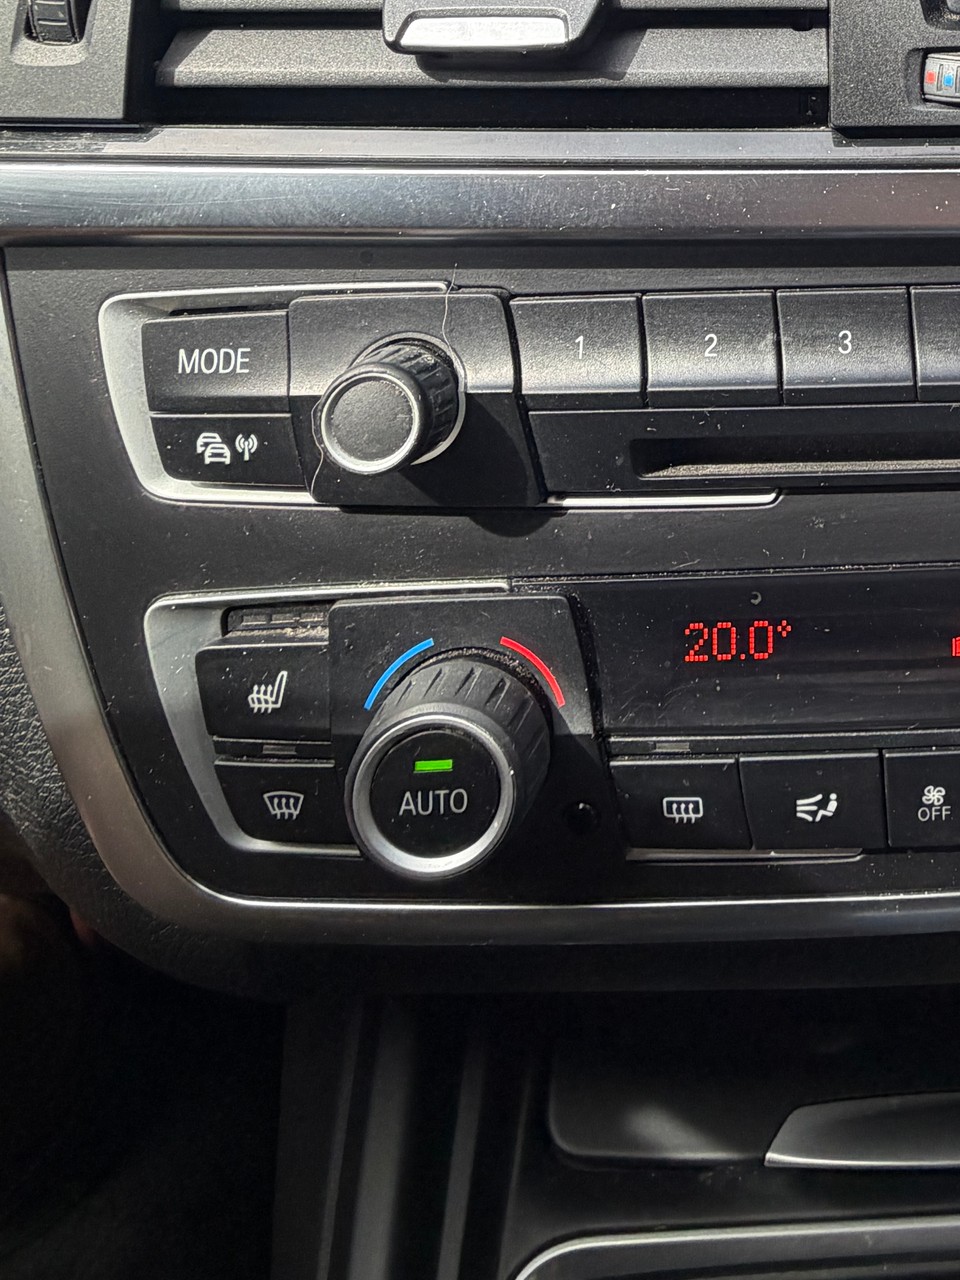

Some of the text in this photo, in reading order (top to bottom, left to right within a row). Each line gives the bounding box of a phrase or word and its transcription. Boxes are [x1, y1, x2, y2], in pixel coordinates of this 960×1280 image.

[574, 336, 584, 359] 1
[704, 334, 718, 358] 2
[838, 330, 852, 354] 3
[178, 348, 251, 374] MODE
[399, 788, 469, 816] AUTO
[917, 805, 951, 820] OFF
